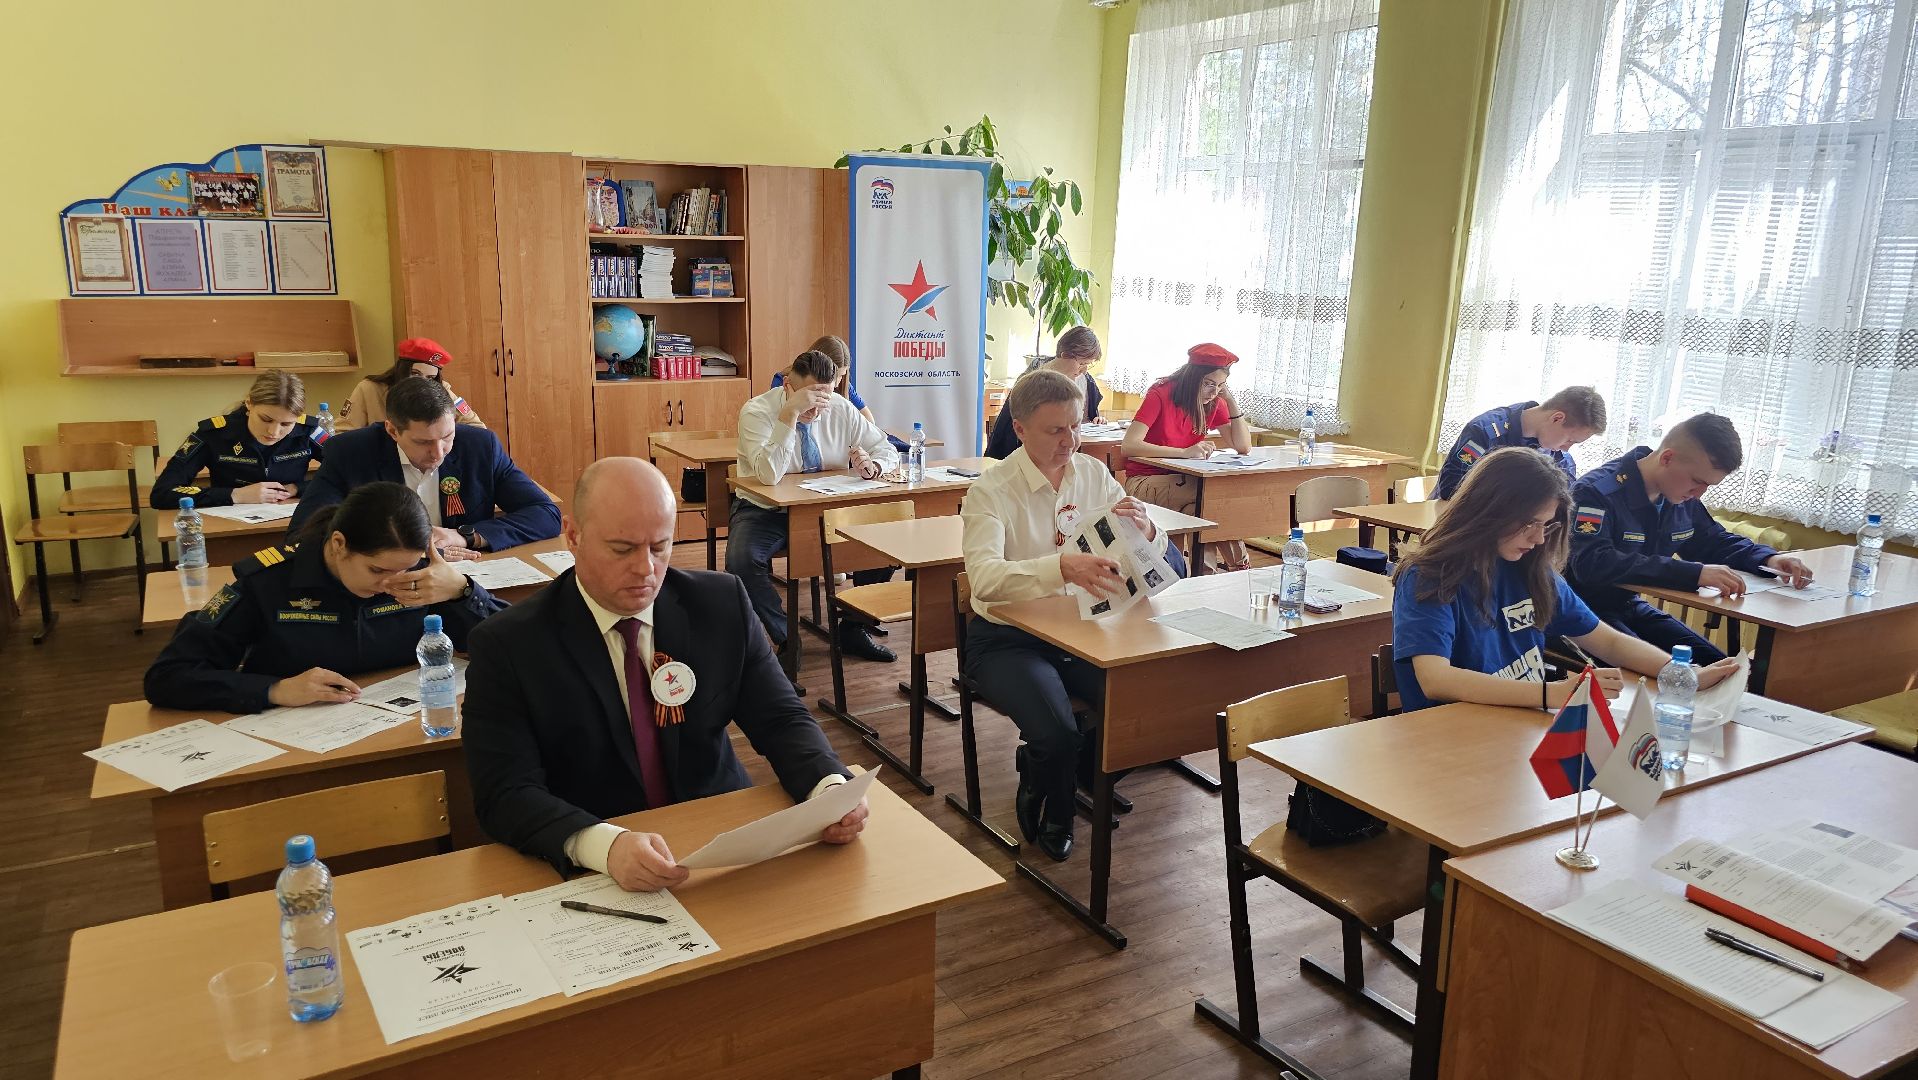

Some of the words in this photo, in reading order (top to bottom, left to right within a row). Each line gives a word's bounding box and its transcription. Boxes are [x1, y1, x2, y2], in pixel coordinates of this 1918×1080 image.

[276, 168, 311, 176] ГРАМОТА
[102, 203, 152, 216] Наш
[893, 327, 946, 339] Диктант
[893, 341, 946, 361] ПОБЕДЫ
[927, 370, 961, 378] ОБЛАСТЬ
